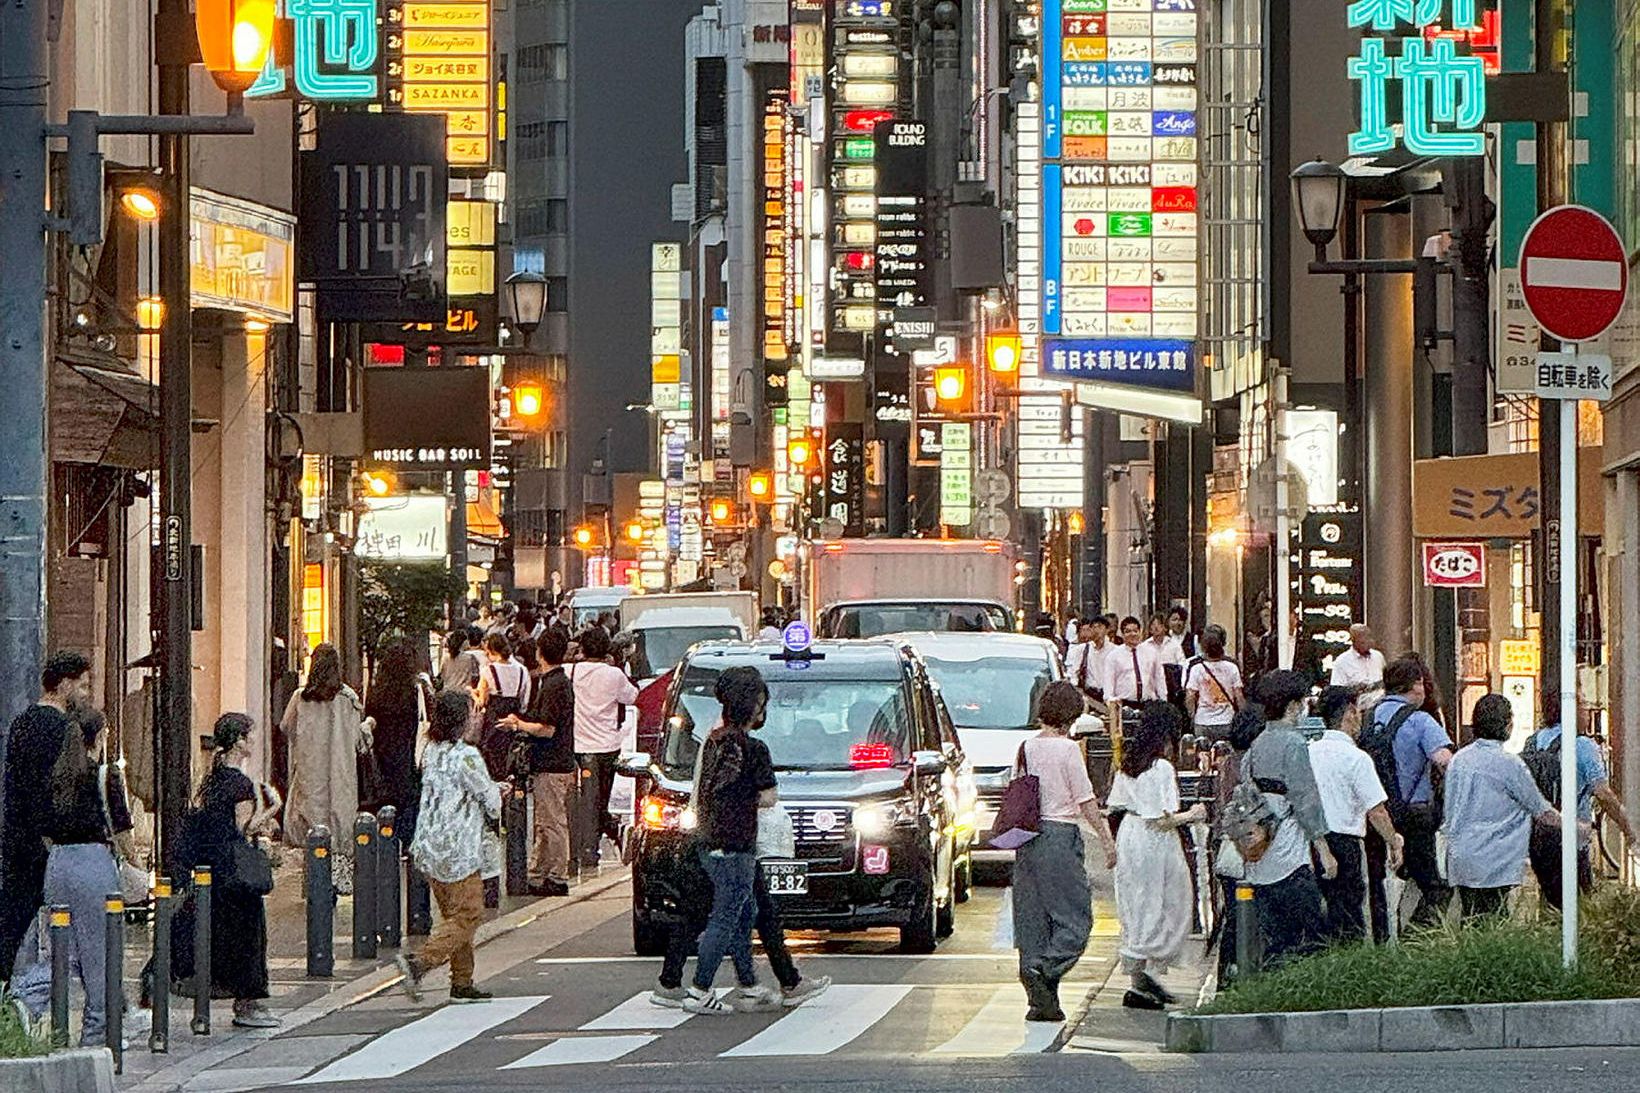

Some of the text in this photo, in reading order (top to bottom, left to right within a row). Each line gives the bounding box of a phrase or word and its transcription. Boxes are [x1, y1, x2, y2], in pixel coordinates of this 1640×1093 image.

[413, 63, 477, 75] ジョイ美容室
[412, 89, 479, 99] SAZANKA
[893, 123, 926, 135] ROUND
[889, 135, 926, 146] BUILDING
[1068, 242, 1098, 256] ROUGE
[893, 321, 935, 334] ENISHI
[1052, 350, 1188, 371] 新日本新地ビル東館
[1538, 363, 1610, 390] 自転車を除く
[373, 448, 482, 461] MUSIC BAR SOIL
[1434, 556, 1473, 572] たばこ
